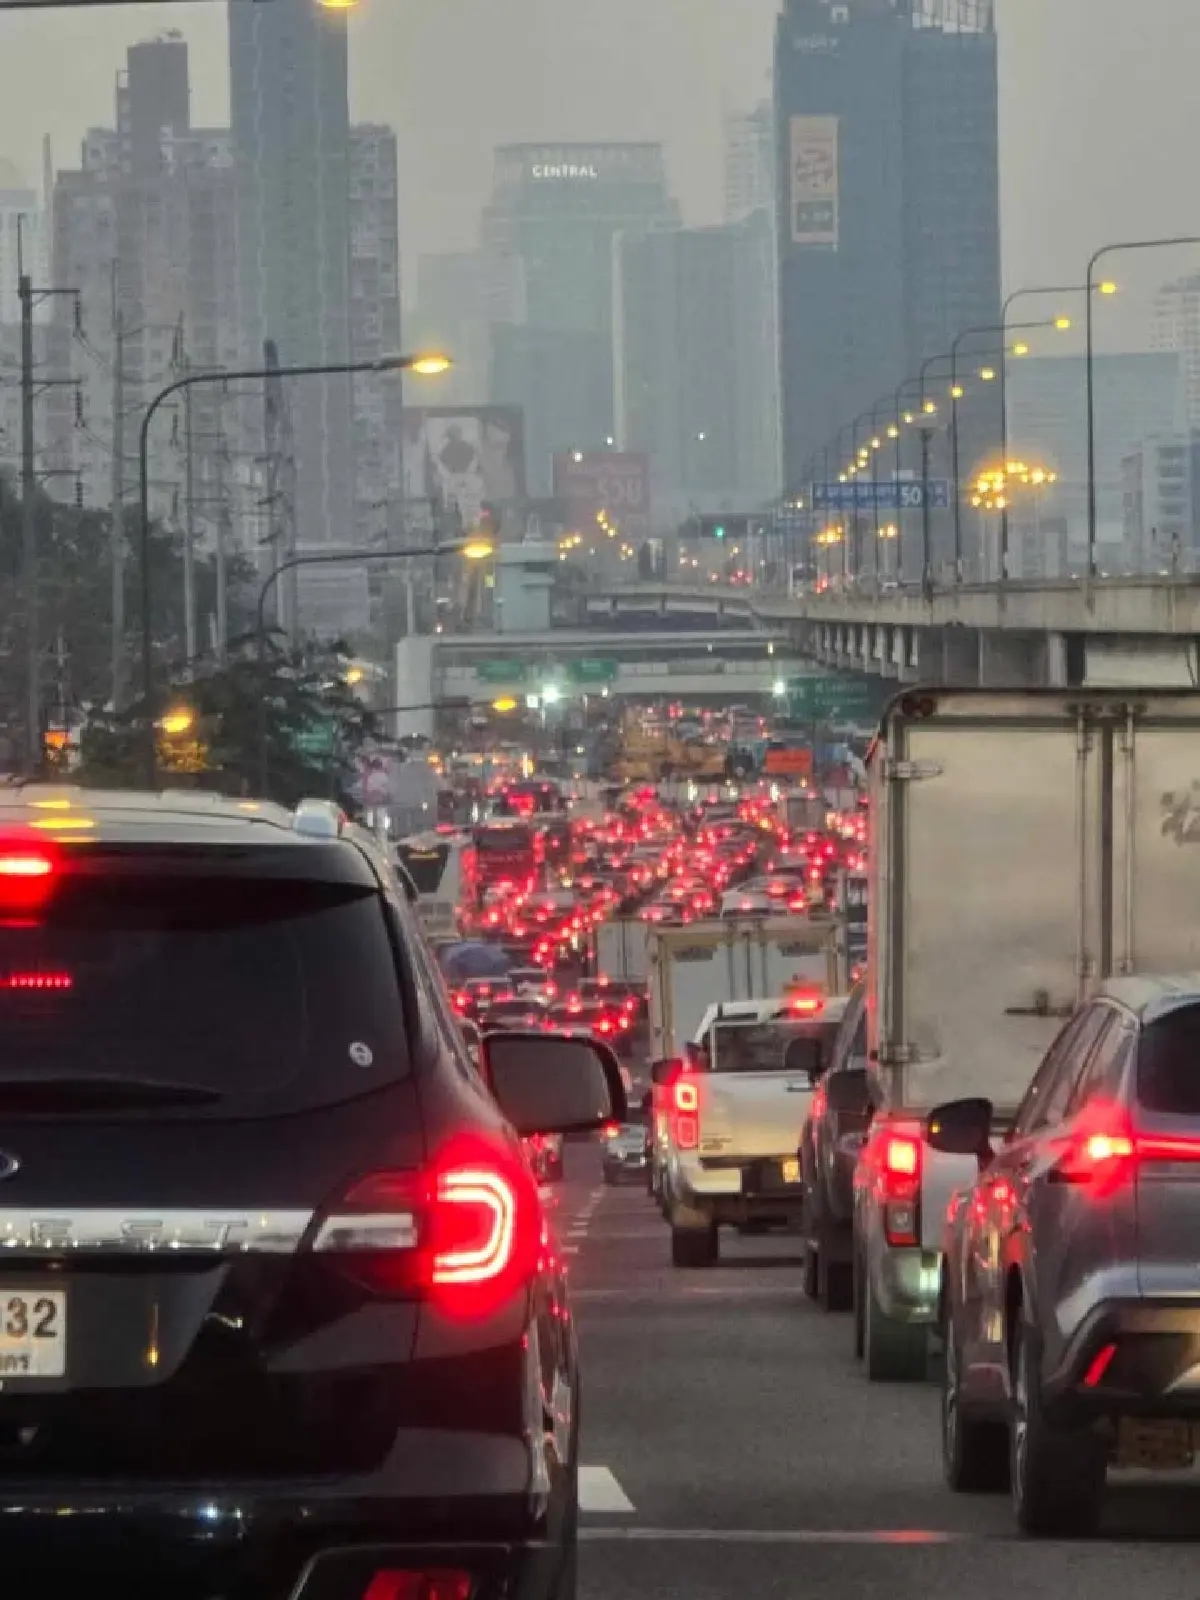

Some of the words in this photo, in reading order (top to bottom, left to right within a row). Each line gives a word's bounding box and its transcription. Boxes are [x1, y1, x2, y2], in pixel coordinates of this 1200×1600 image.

[532, 165, 598, 179] CENTRAL
[901, 485, 921, 505] 50
[0, 1297, 58, 1338] 32
